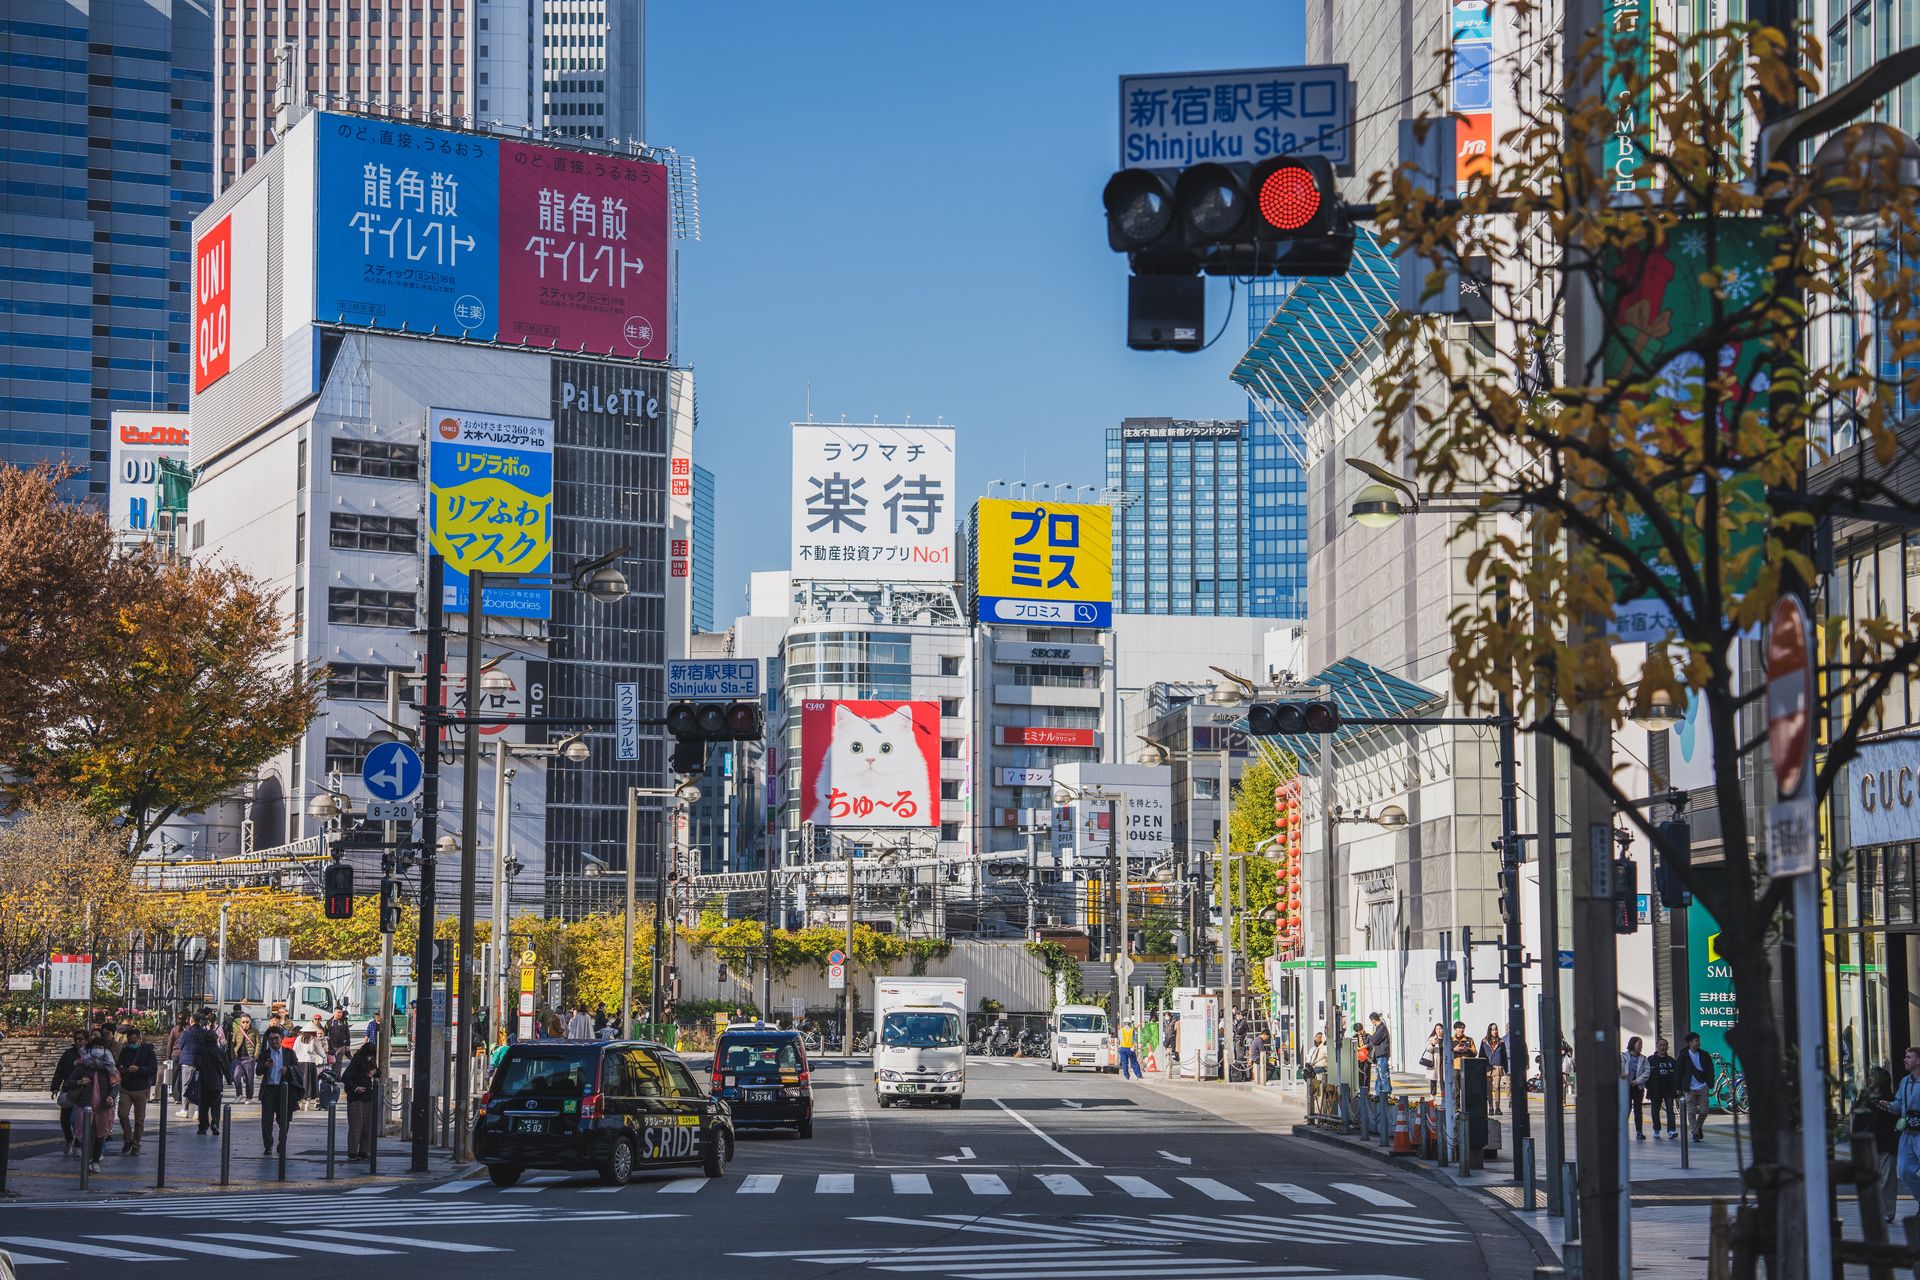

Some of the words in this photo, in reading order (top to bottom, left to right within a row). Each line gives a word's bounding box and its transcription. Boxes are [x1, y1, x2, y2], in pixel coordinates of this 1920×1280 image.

[1129, 80, 1337, 128] 新宿駅東口
[338, 124, 485, 159] のど、直接、うるおう
[1127, 130, 1243, 165] Shinjuku
[1458, 140, 1487, 158] JTB
[514, 152, 652, 184] のど、直接、うるおう
[363, 161, 459, 217] 龍角散
[538, 187, 628, 241] 龍角散
[349, 212, 476, 267] ダイレクト
[364, 264, 414, 280] スティック
[525, 236, 645, 289] ダイレクト
[540, 286, 586, 302] スティック
[456, 303, 482, 320] 生薬
[625, 323, 651, 340] 生薬
[441, 425, 457, 433] OHKI
[464, 420, 545, 436] おかげさまで360余年
[1123, 428, 1240, 438] 住友不動産新宿グランドタワー
[823, 443, 926, 462] ラクマチ
[456, 452, 531, 477] リブラボの
[448, 495, 540, 527] リブふわ
[805, 472, 945, 536] 楽待
[1010, 506, 1080, 548] プロ
[444, 531, 537, 566] マスク
[1011, 552, 1080, 589] ミス
[1015, 604, 1061, 618] プロミス
[1031, 648, 1071, 659] SECRE
[671, 664, 754, 681] 新宿駅東口
[670, 682, 717, 696] Shinjuku
[452, 690, 521, 709] スロー
[621, 686, 634, 758] スクランブル式
[1019, 773, 1043, 781] セブン
[1861, 766, 1920, 814] GUC
[1126, 830, 1163, 841] OUSE
[1700, 1020, 1738, 1028] PRES
[644, 1116, 677, 1126] タクシーアプリ
[643, 1126, 701, 1159] S.RIDE
